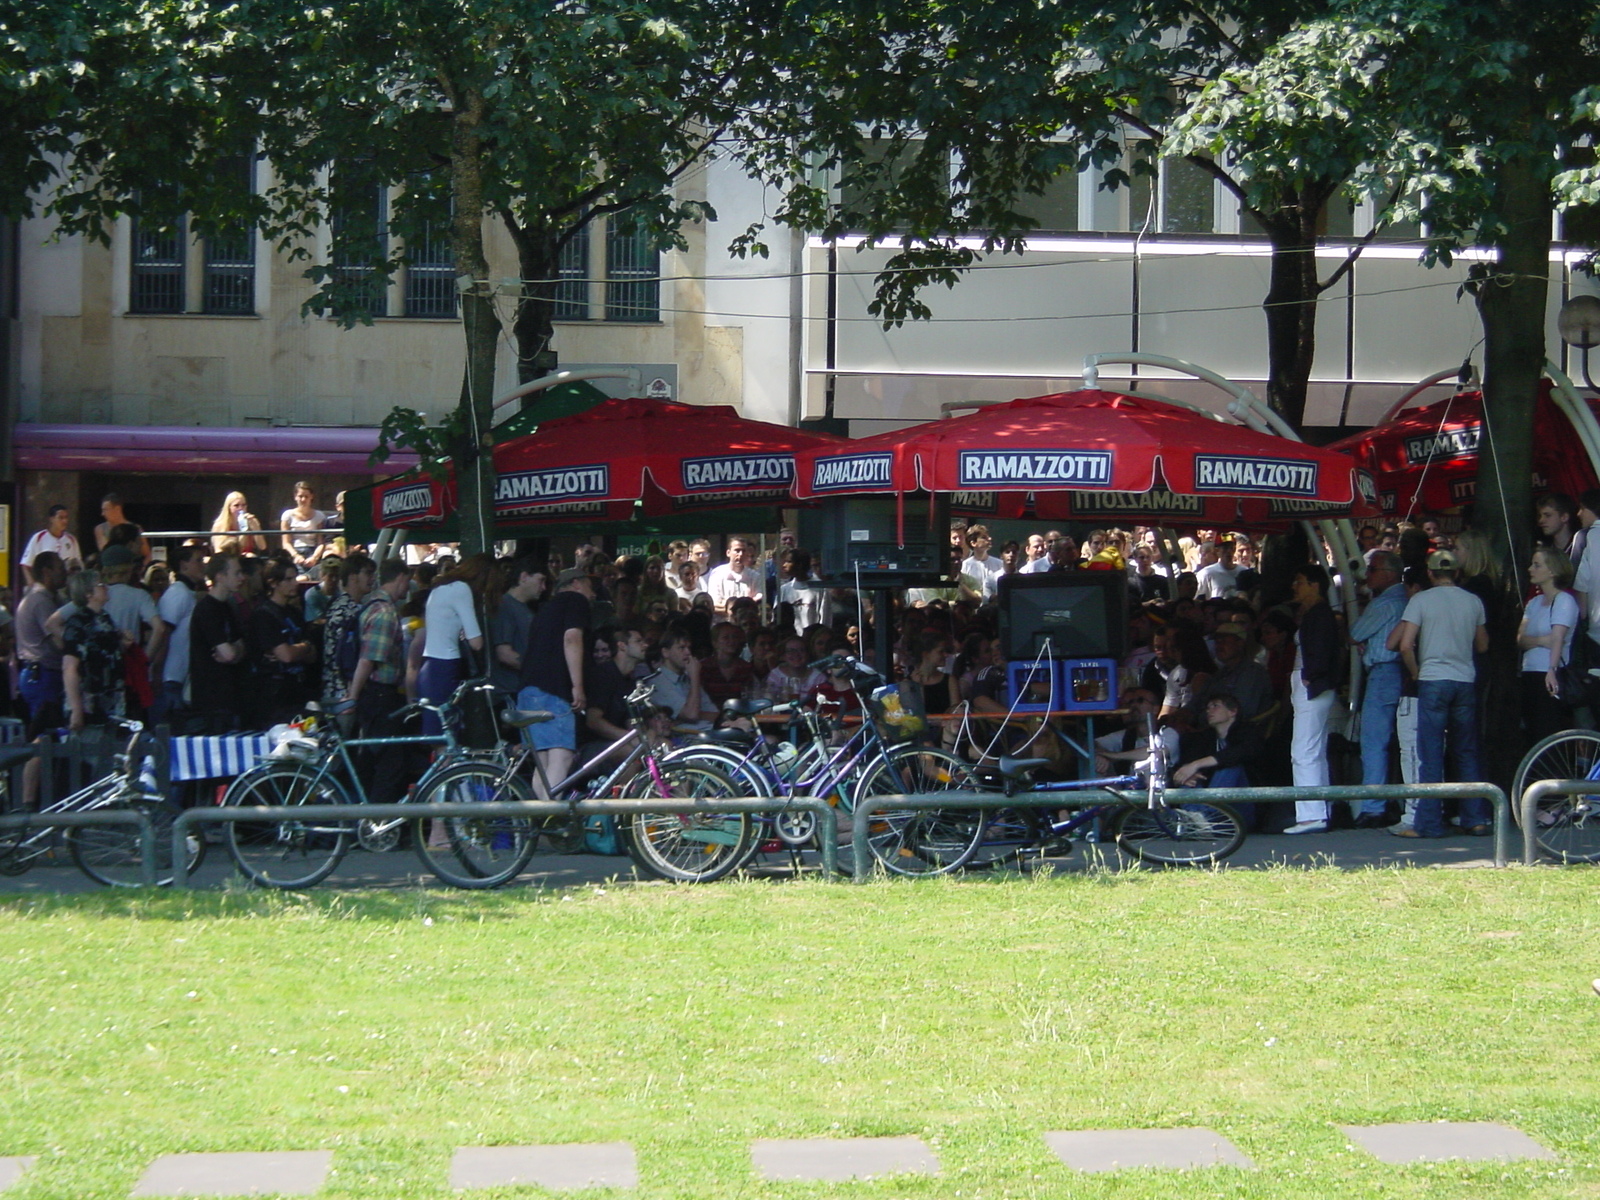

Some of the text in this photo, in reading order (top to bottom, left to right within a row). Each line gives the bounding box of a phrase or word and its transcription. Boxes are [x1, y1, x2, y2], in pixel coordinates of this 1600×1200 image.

[1410, 431, 1480, 459] RAMAZZ
[687, 458, 794, 485] RAMAZZOT
[815, 458, 890, 486] RAMAZZOTTI
[965, 455, 1106, 480] RAMAZZOTTI
[1199, 461, 1313, 490] RAMAZZOTTI
[494, 470, 604, 500] AMAZZOTTI
